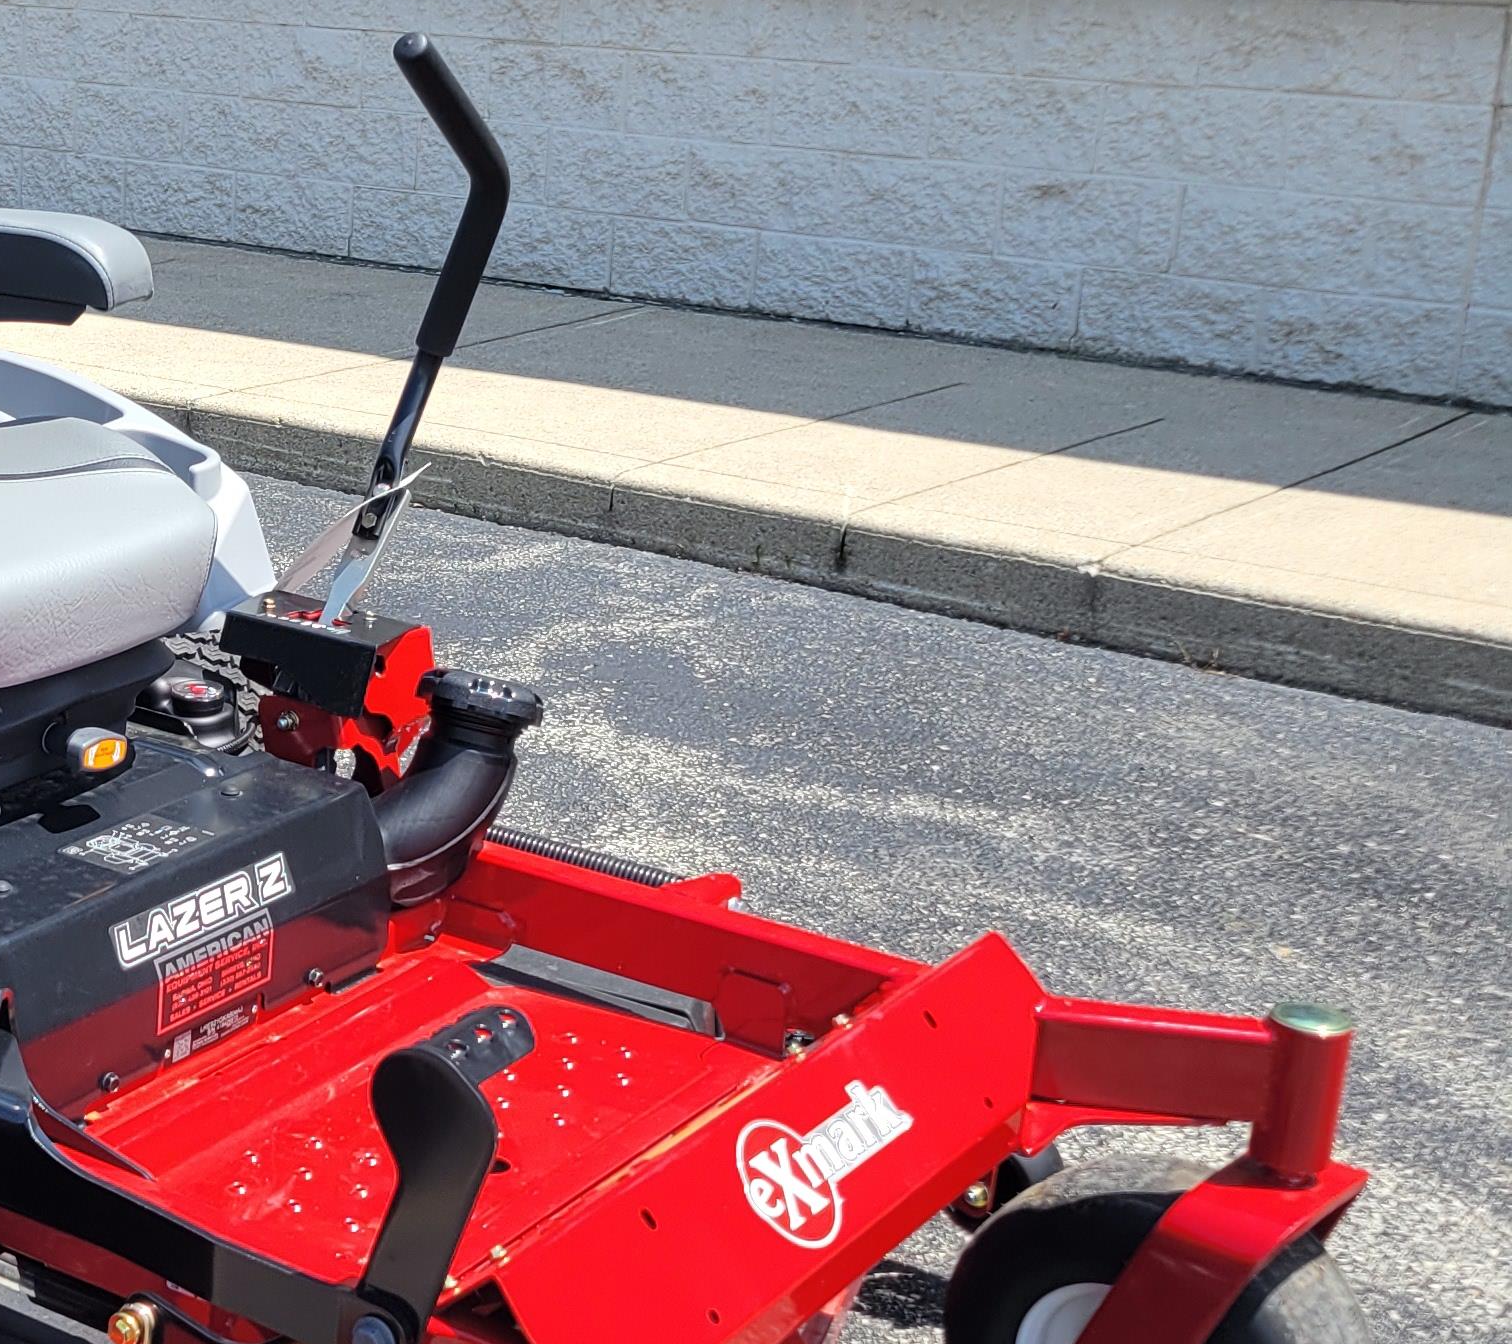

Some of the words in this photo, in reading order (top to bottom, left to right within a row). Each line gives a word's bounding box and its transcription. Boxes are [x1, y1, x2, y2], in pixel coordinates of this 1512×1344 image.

[116, 872, 255, 965] LAZER
[257, 856, 290, 904] Z
[164, 917, 270, 984] AMERICAN
